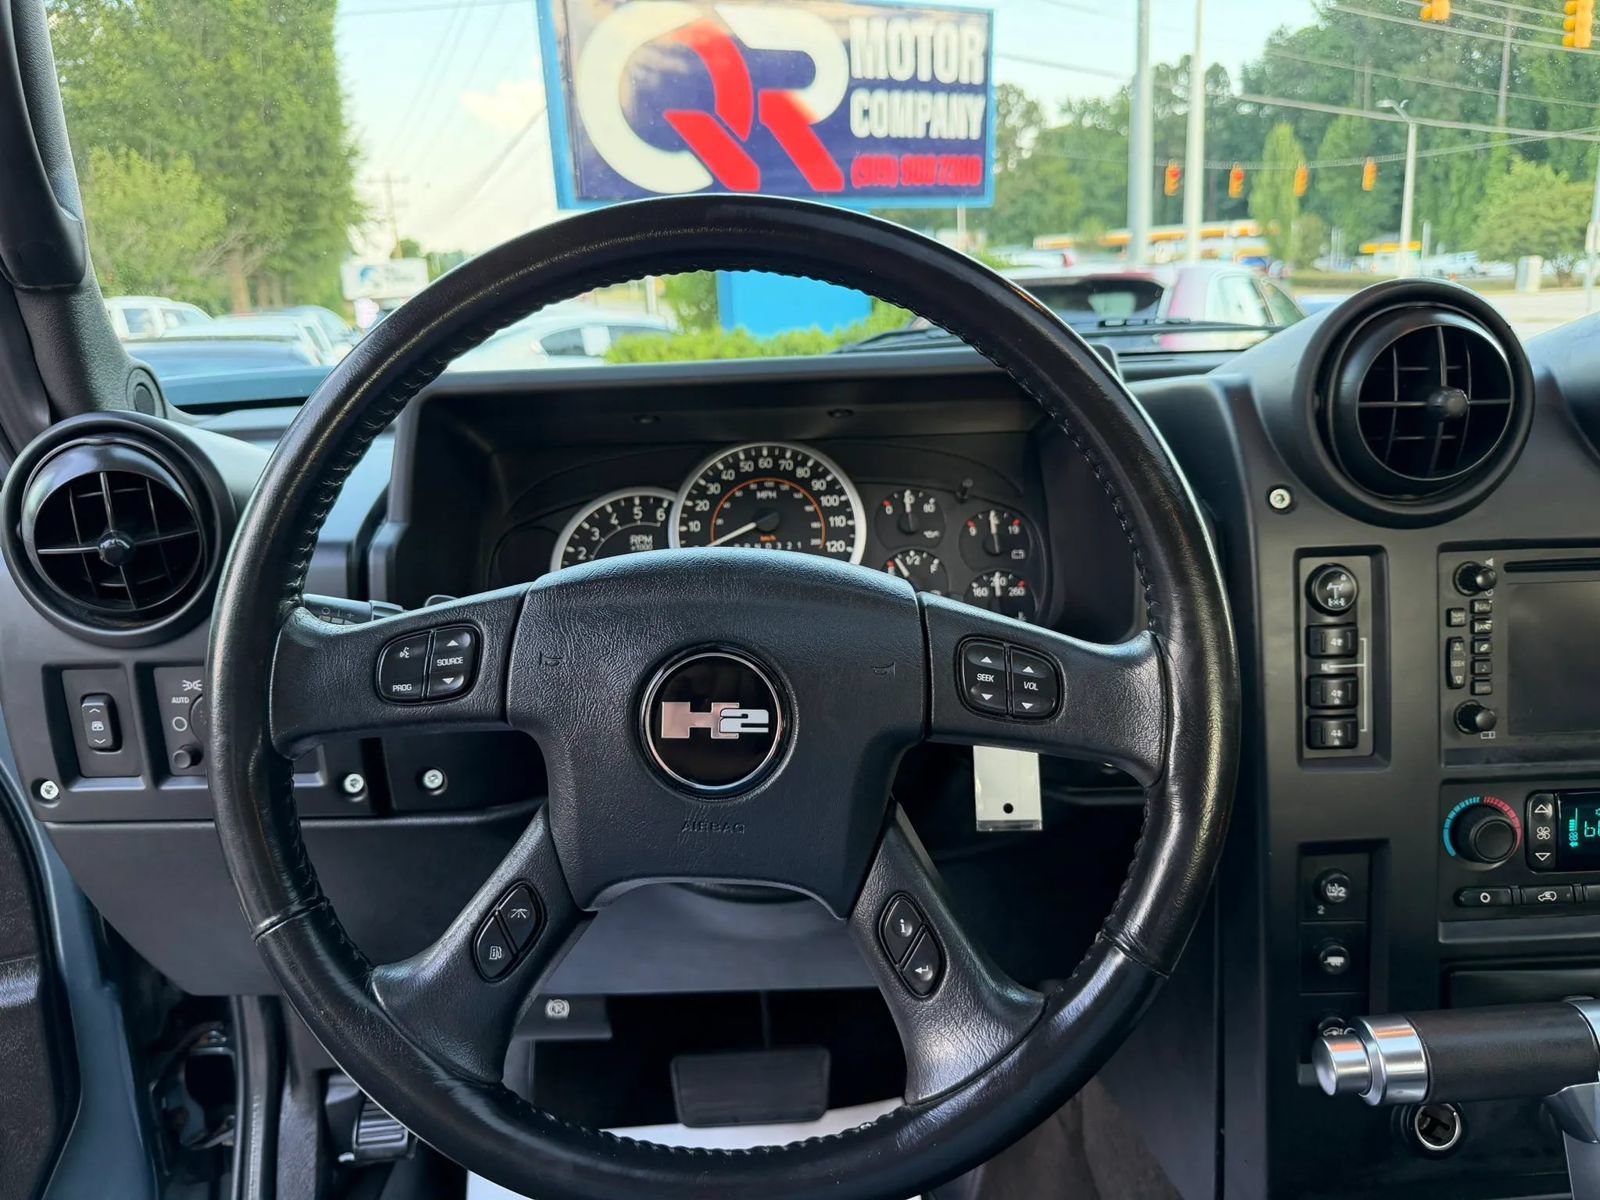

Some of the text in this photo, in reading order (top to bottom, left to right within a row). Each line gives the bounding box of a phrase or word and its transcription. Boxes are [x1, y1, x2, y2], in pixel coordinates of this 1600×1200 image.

[849, 17, 987, 85] MOTOR
[850, 88, 986, 140] COMPANY
[739, 460, 754, 472] 50
[758, 457, 773, 469] 60
[778, 458, 794, 471] 70
[721, 469, 735, 481] 40
[796, 466, 810, 478] 80
[707, 482, 720, 494] 30
[811, 479, 826, 491] 90
[695, 500, 709, 512] 20
[820, 495, 840, 506] 100
[610, 512, 619, 525] 4
[633, 506, 642, 519] 5
[656, 508, 666, 520] 6
[688, 521, 700, 532] 10
[829, 516, 846, 528] 110
[590, 527, 600, 540] 3
[1008, 525, 1020, 535] 19
[630, 535, 652, 545] RPM
[826, 540, 846, 552] 120
[577, 547, 587, 560] 2
[437, 657, 463, 666] SOURCE
[977, 673, 994, 682] SEEK
[1024, 682, 1038, 690] VOL
[661, 701, 769, 739] H2
[682, 823, 745, 834] AIRBAG
